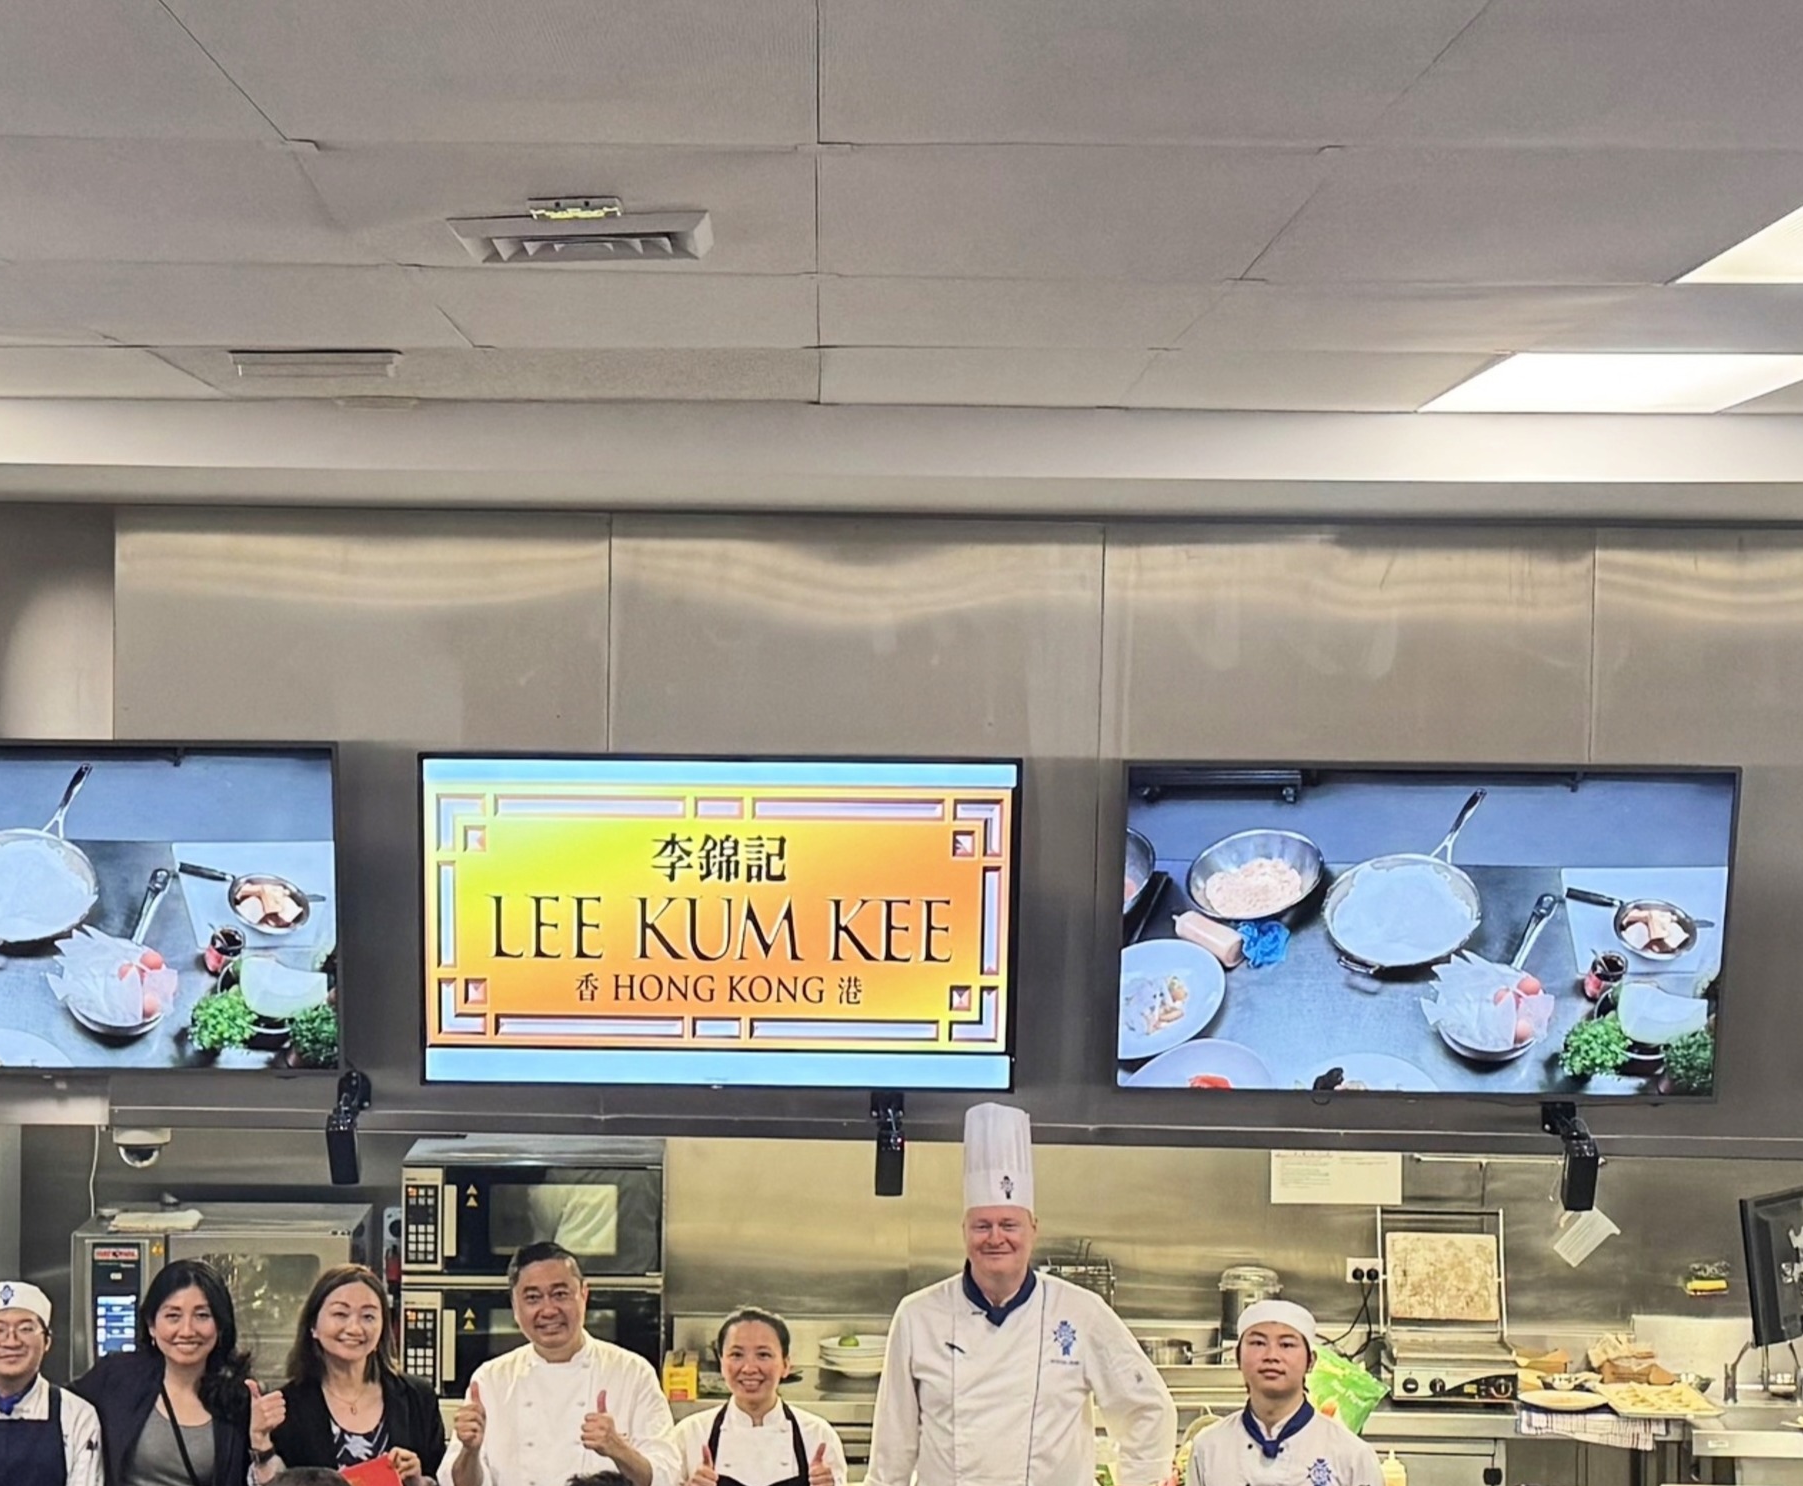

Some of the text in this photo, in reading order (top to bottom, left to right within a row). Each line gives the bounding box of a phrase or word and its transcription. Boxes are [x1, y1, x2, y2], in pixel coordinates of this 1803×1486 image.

[652, 832, 787, 883] 李錦記
[486, 893, 953, 963] LEE KUM KEE
[576, 973, 863, 1005] 香 HONG KONG 港
